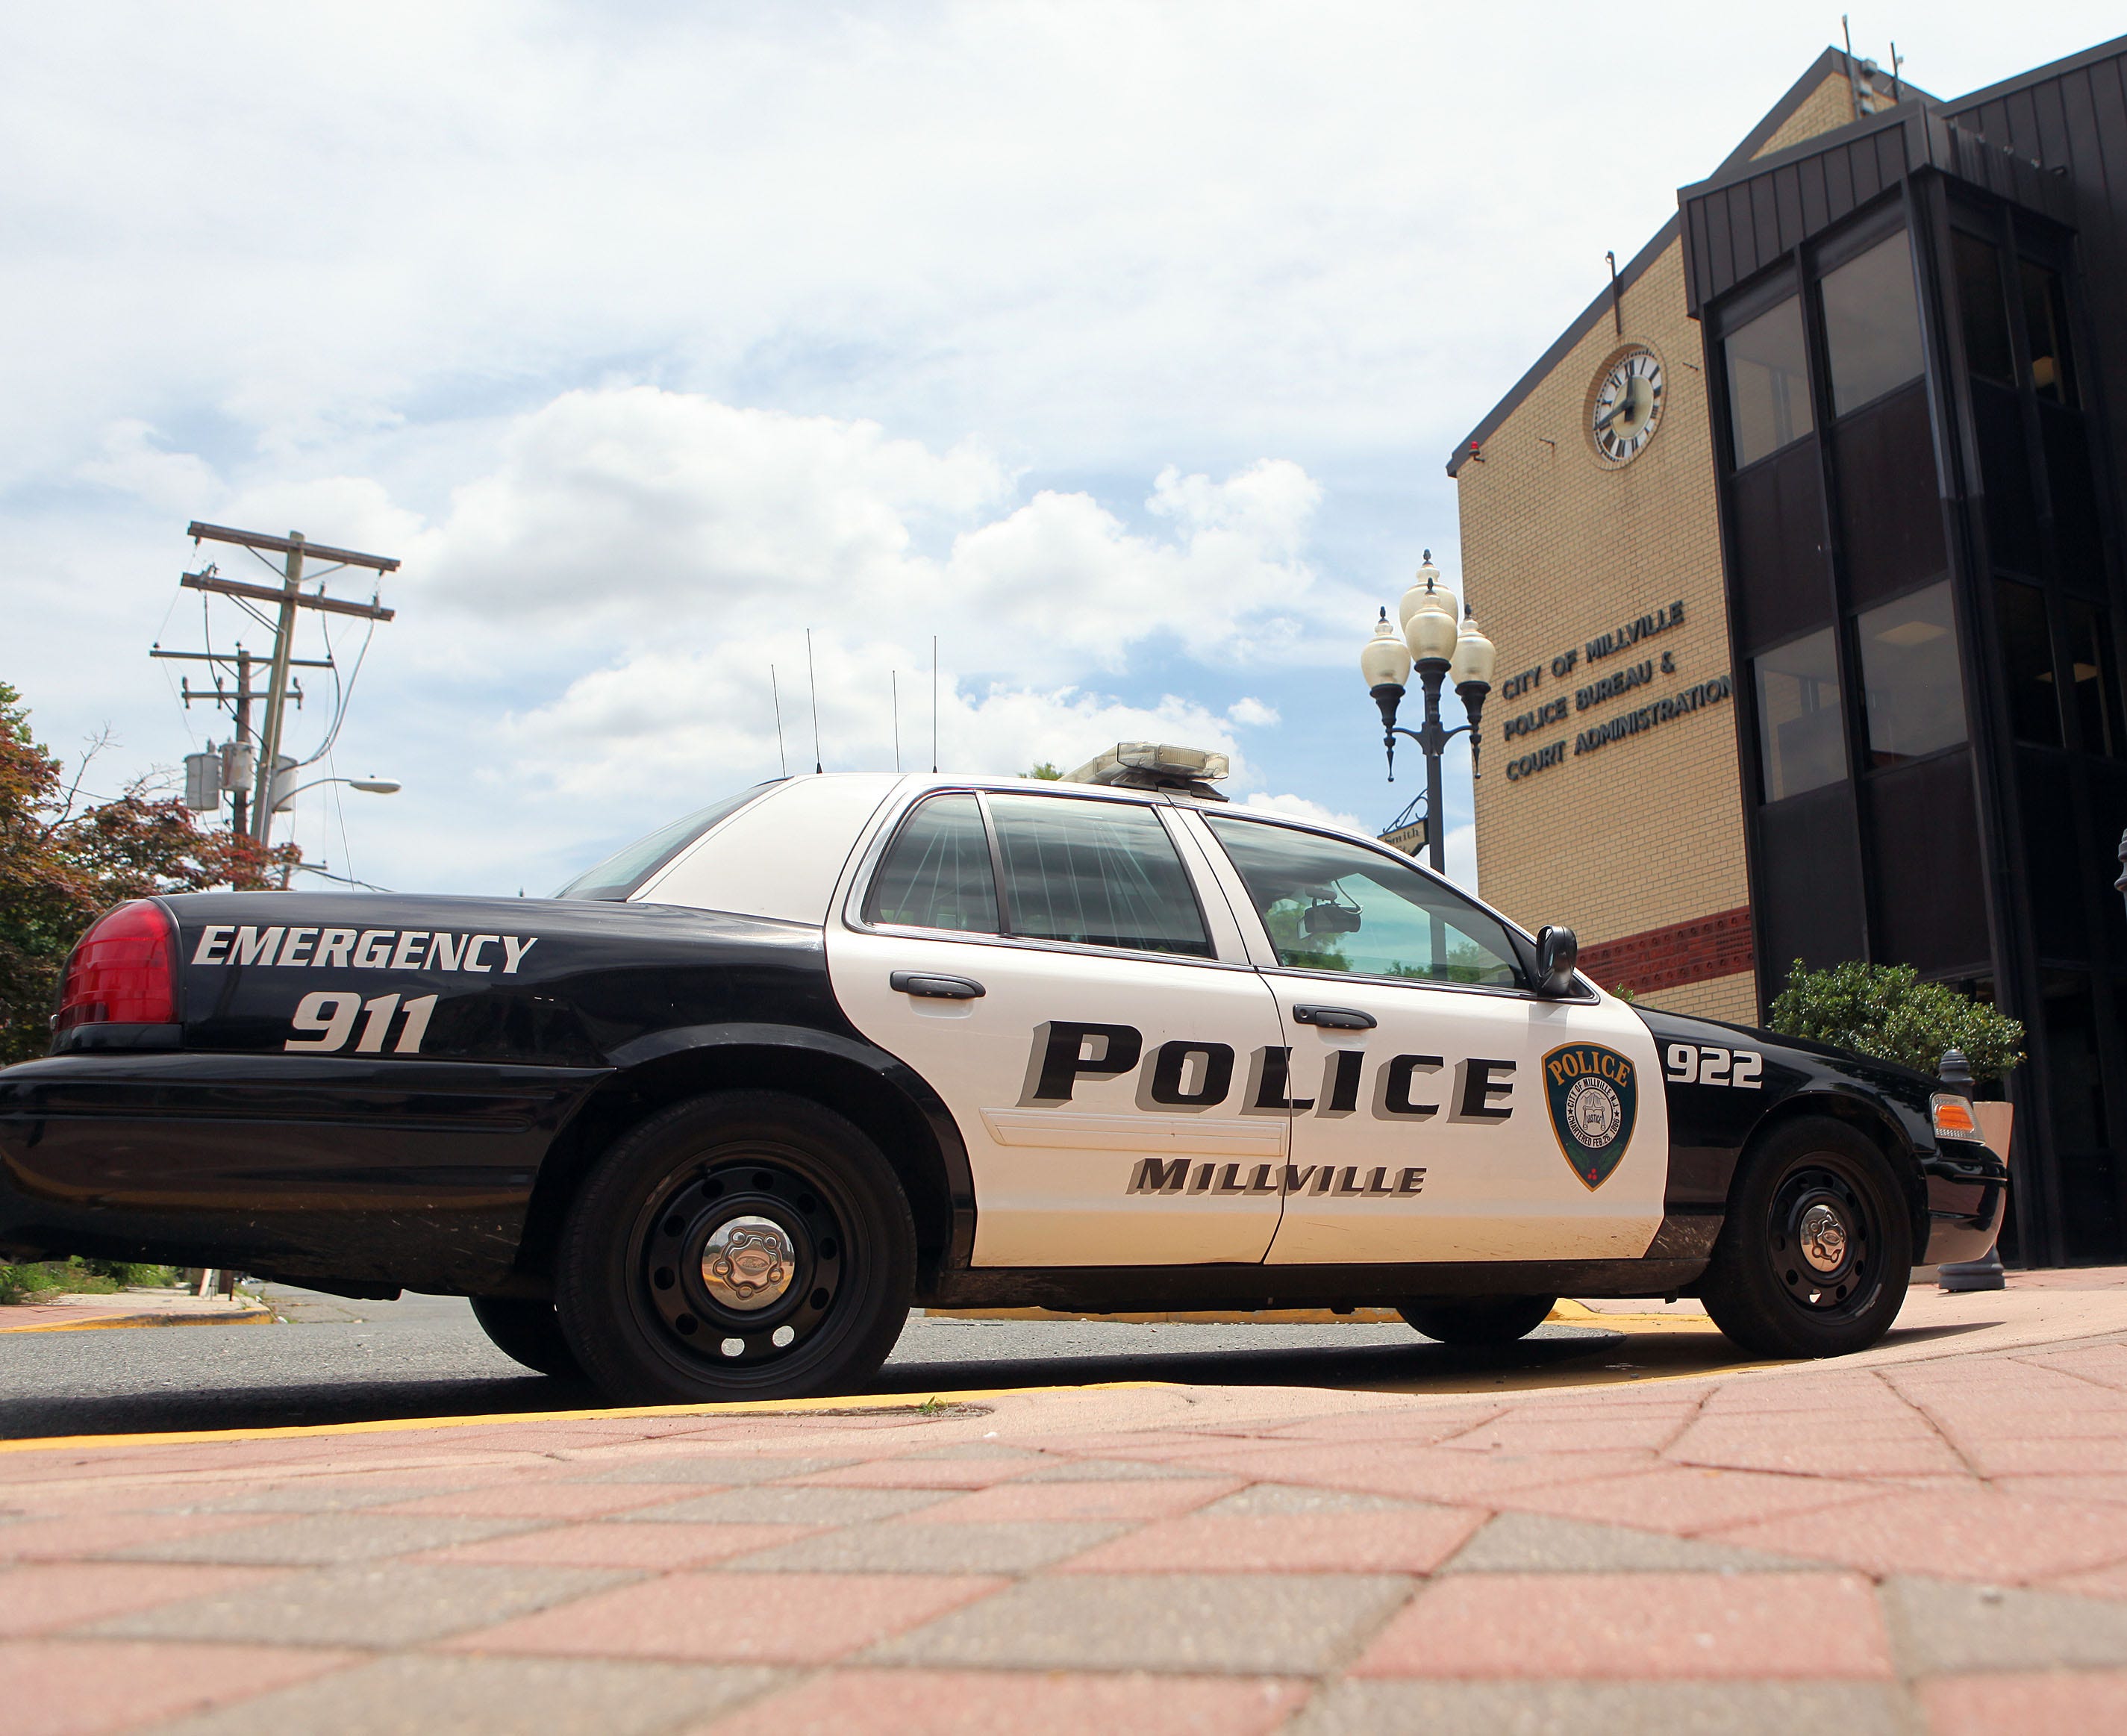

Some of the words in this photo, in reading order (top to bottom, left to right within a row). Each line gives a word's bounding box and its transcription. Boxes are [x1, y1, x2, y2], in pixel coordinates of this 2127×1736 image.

[1502, 665, 1542, 700] CITY
[1551, 649, 1577, 678] OF
[1585, 600, 1685, 663] MILLVILLE
[1503, 696, 1568, 741] POLICE
[1575, 660, 1652, 711] BUREAU
[1660, 651, 1675, 673] &
[1505, 740, 1567, 781] COURT
[1574, 675, 1733, 755] ADMINISTRATION
[1384, 828, 1419, 843] Smith
[191, 925, 538, 973] EMERGENCY
[284, 991, 439, 1053] 911
[1016, 1020, 1516, 1124] POLICE
[1548, 1051, 1630, 1087] POLICE
[1667, 1043, 1763, 1089] 922
[1567, 1090, 1577, 1108] CITY
[1575, 1081, 1582, 1092] OF
[1583, 1078, 1612, 1096] MILLVILLE
[1567, 1115, 1592, 1146] CHARTERED
[1125, 1158, 1426, 1198] MILLVILLE
